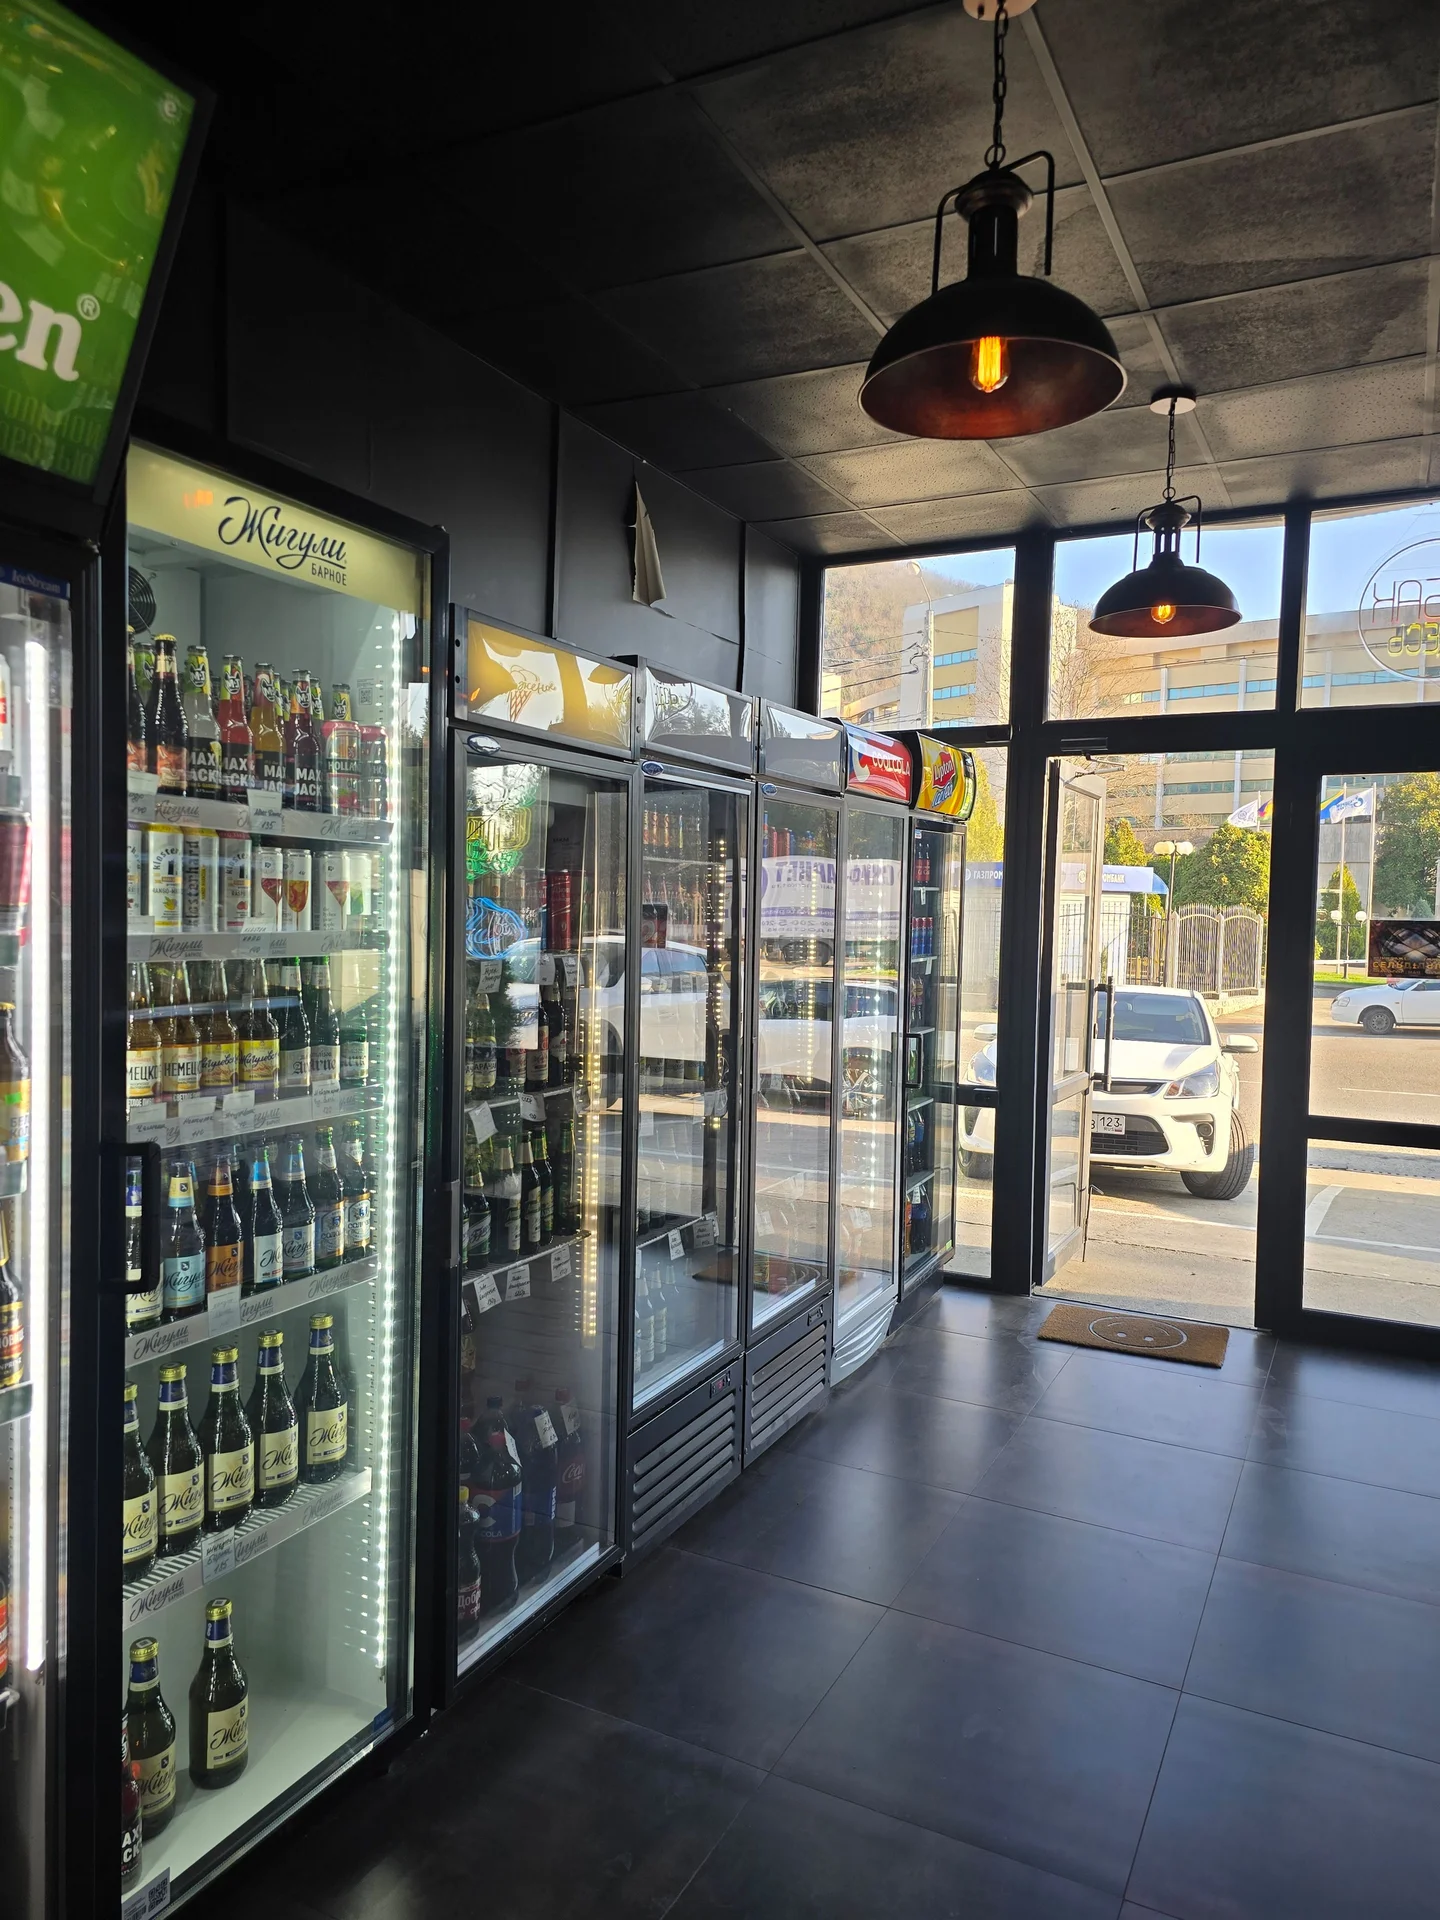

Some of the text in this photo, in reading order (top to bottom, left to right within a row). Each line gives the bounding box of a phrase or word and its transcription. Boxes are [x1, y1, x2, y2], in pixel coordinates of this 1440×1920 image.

[218, 496, 346, 570] Жигули
[311, 562, 347, 587] БАРНОЕ
[933, 760, 954, 782] Lipton
[1099, 1116, 1120, 1128] 123
[133, 1325, 189, 1360] Жигули
[130, 1577, 184, 1622] Жигули
